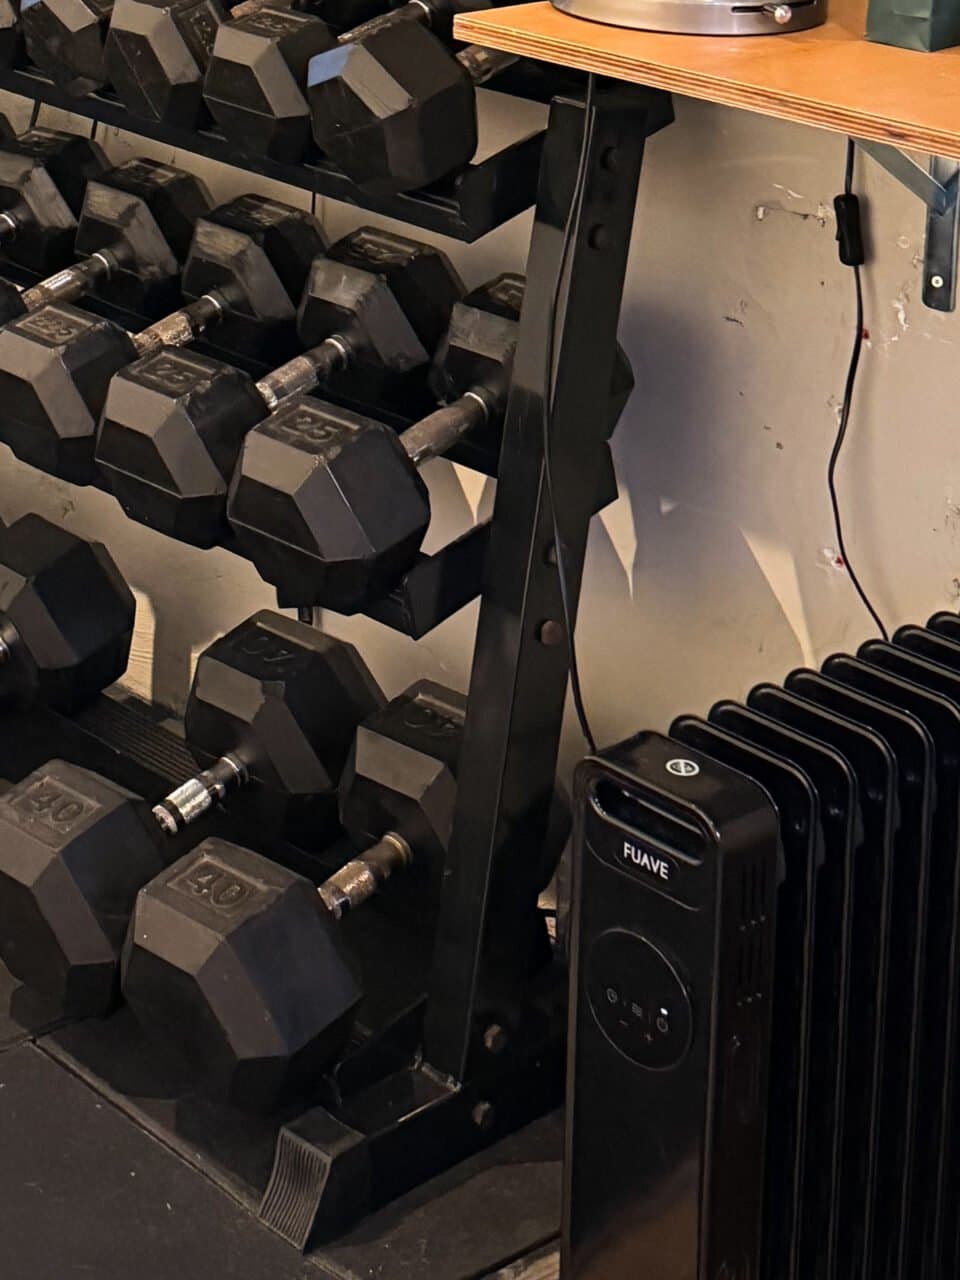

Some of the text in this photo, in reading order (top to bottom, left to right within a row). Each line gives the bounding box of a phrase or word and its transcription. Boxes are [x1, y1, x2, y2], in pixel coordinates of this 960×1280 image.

[29, 791, 86, 825] 40
[623, 841, 669, 880] FUAVE
[185, 870, 250, 908] 40
